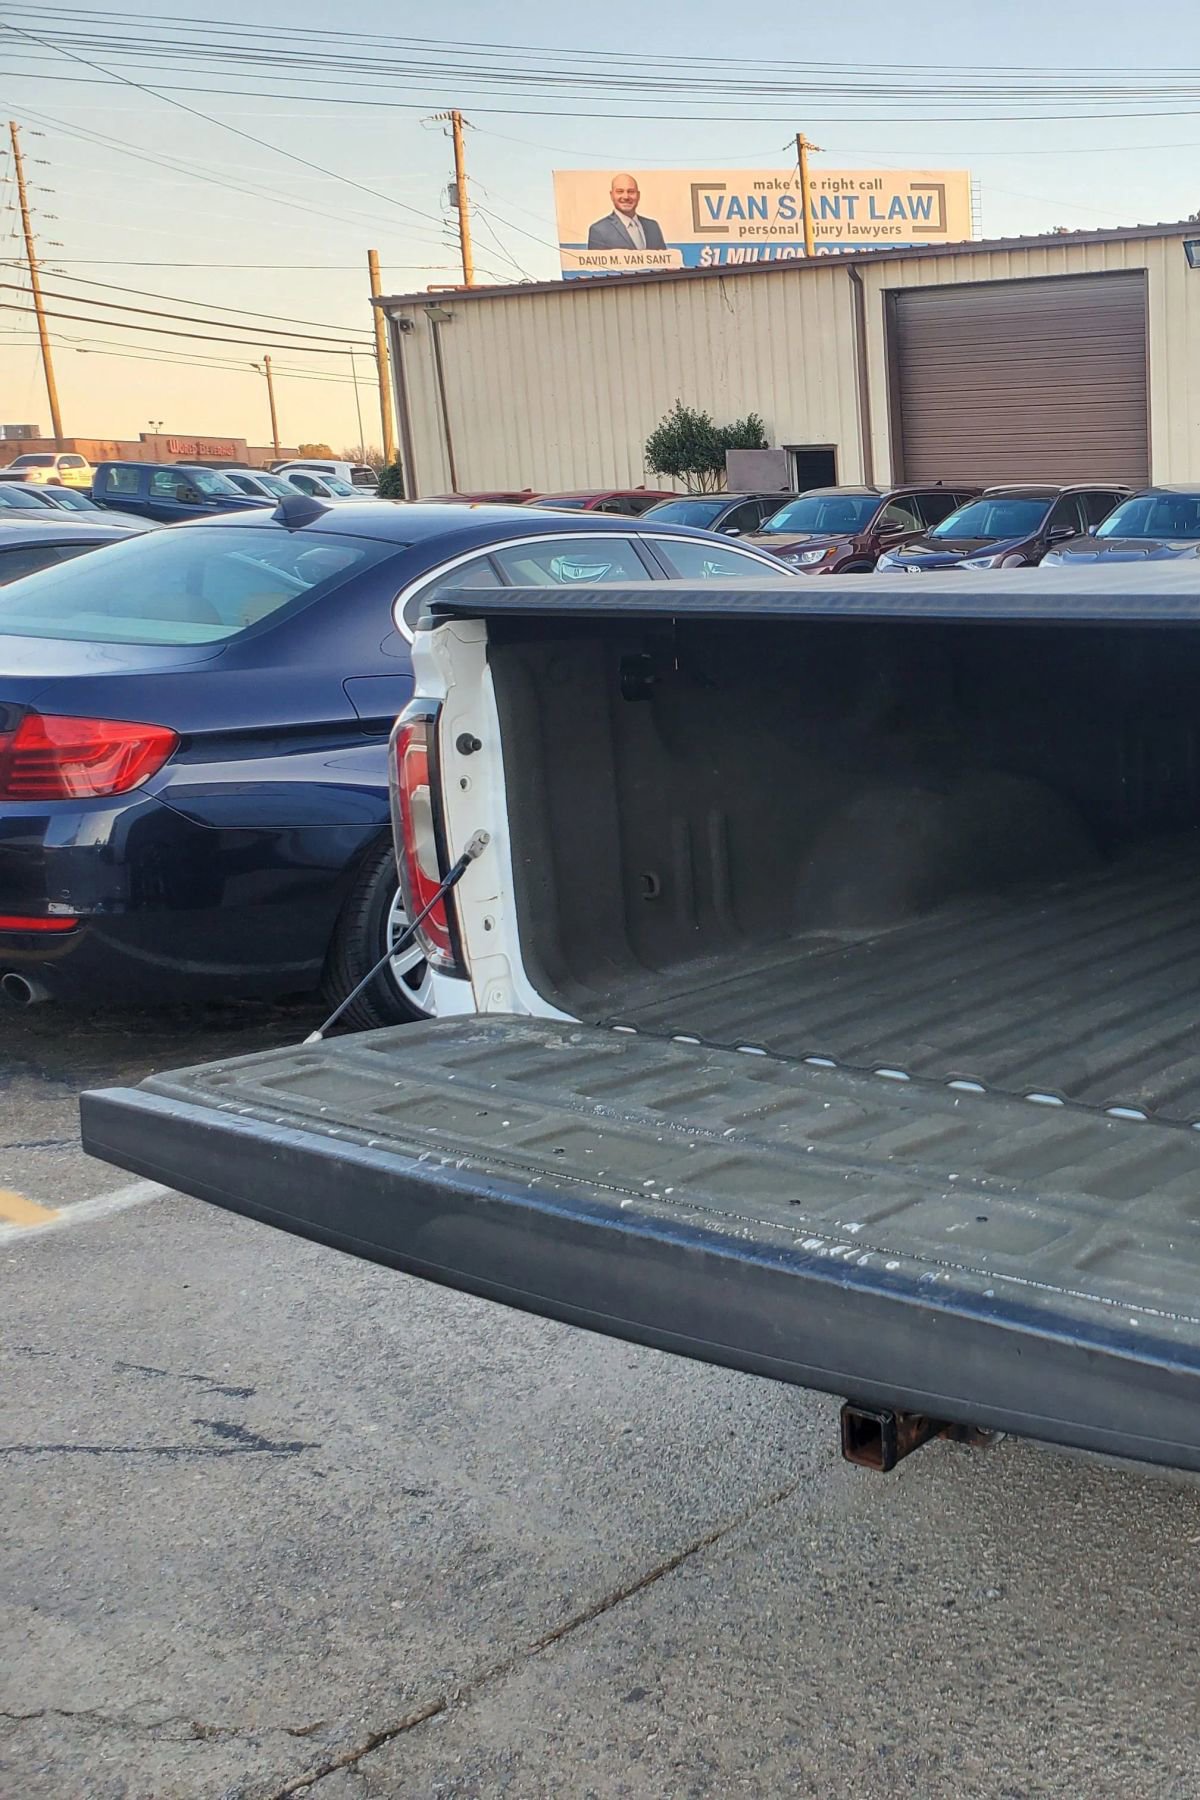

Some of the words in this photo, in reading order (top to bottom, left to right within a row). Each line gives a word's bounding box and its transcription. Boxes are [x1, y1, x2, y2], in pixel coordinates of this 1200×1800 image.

[753, 178, 791, 190] make
[795, 179, 817, 190] te
[821, 178, 855, 192] right
[859, 178, 883, 190] call
[704, 195, 768, 220] VAN
[869, 195, 933, 220] LAW
[739, 222, 799, 238] personal
[847, 222, 902, 238] lawyers
[578, 255, 608, 266] DAVID
[610, 255, 622, 265] M.
[624, 254, 644, 265] VAN
[646, 254, 672, 265] SANT
[700, 245, 721, 267] $1
